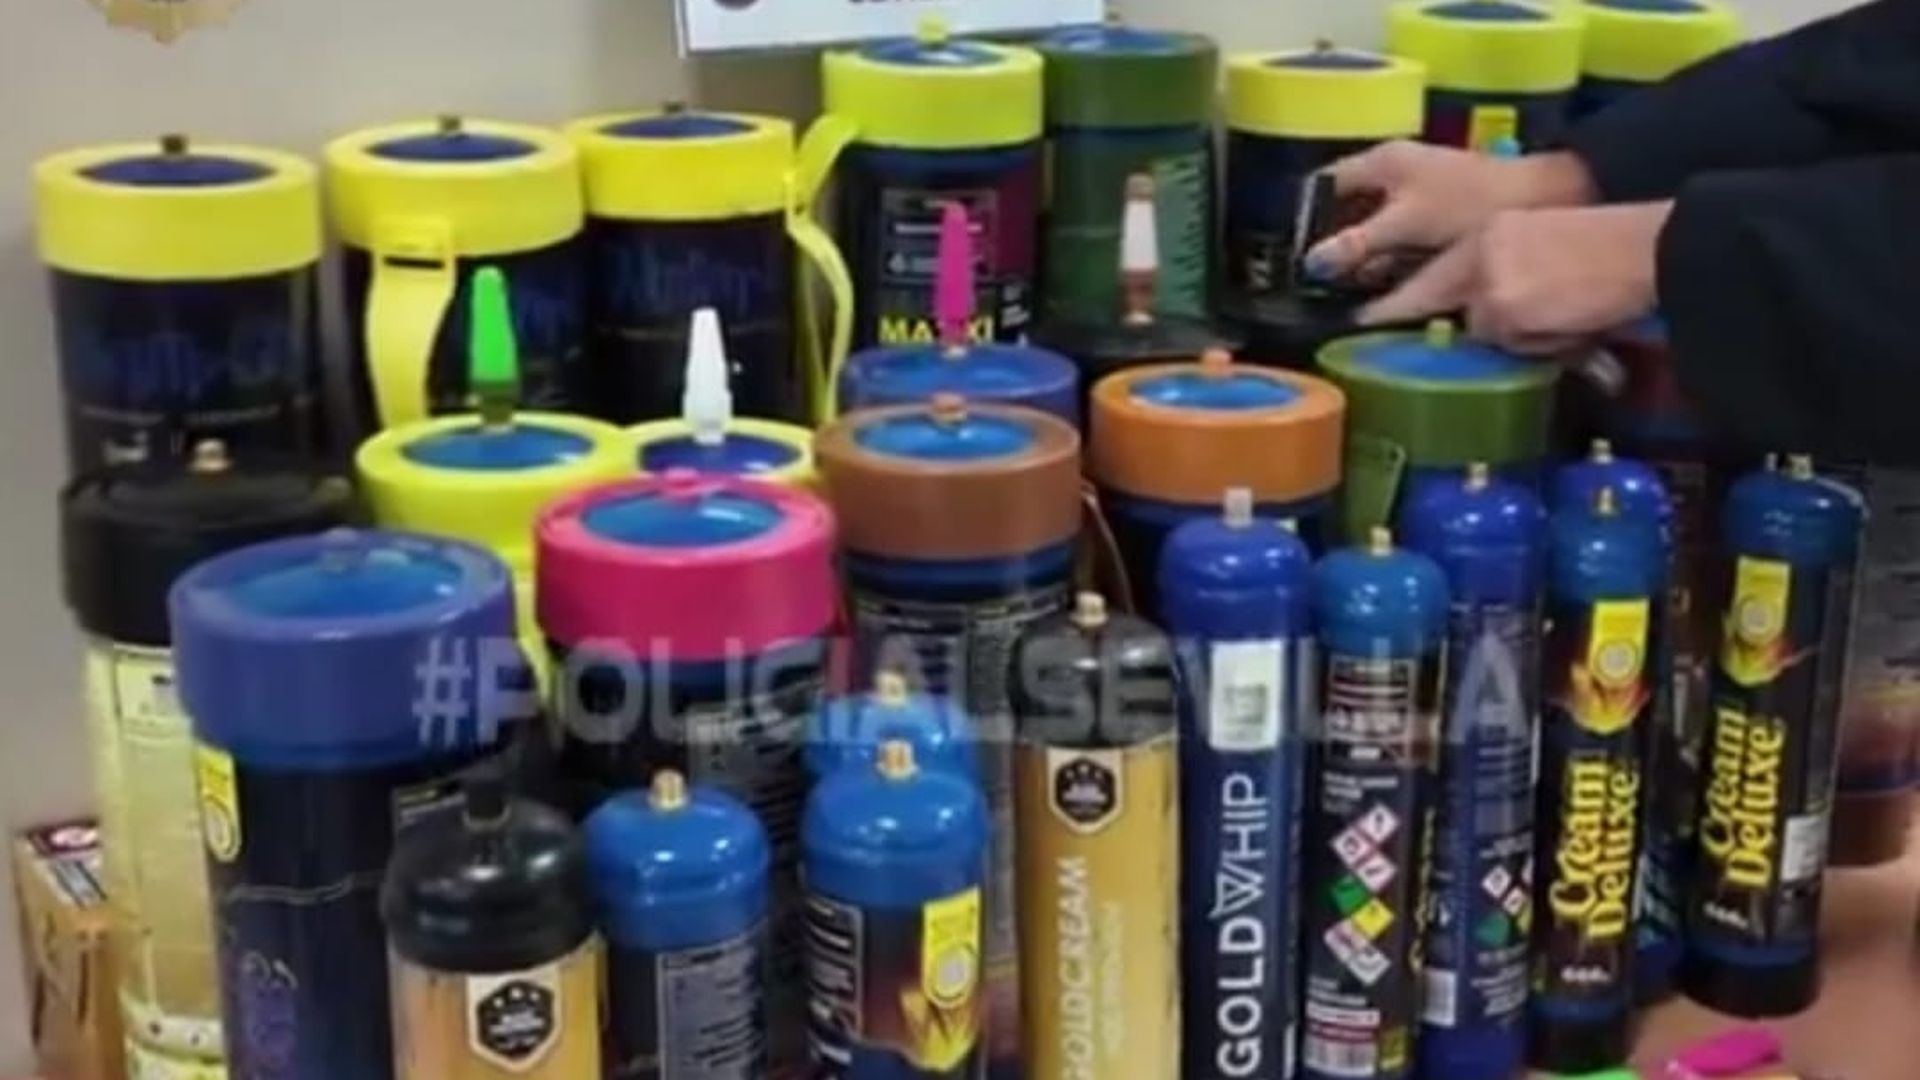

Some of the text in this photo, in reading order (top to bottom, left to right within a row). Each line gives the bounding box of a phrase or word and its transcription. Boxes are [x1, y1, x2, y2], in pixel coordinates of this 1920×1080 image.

[1550, 760, 1606, 921] Cream
[1587, 768, 1640, 937] Deluxe
[1701, 706, 1747, 857] Cream
[1726, 715, 1786, 888] Deluxe
